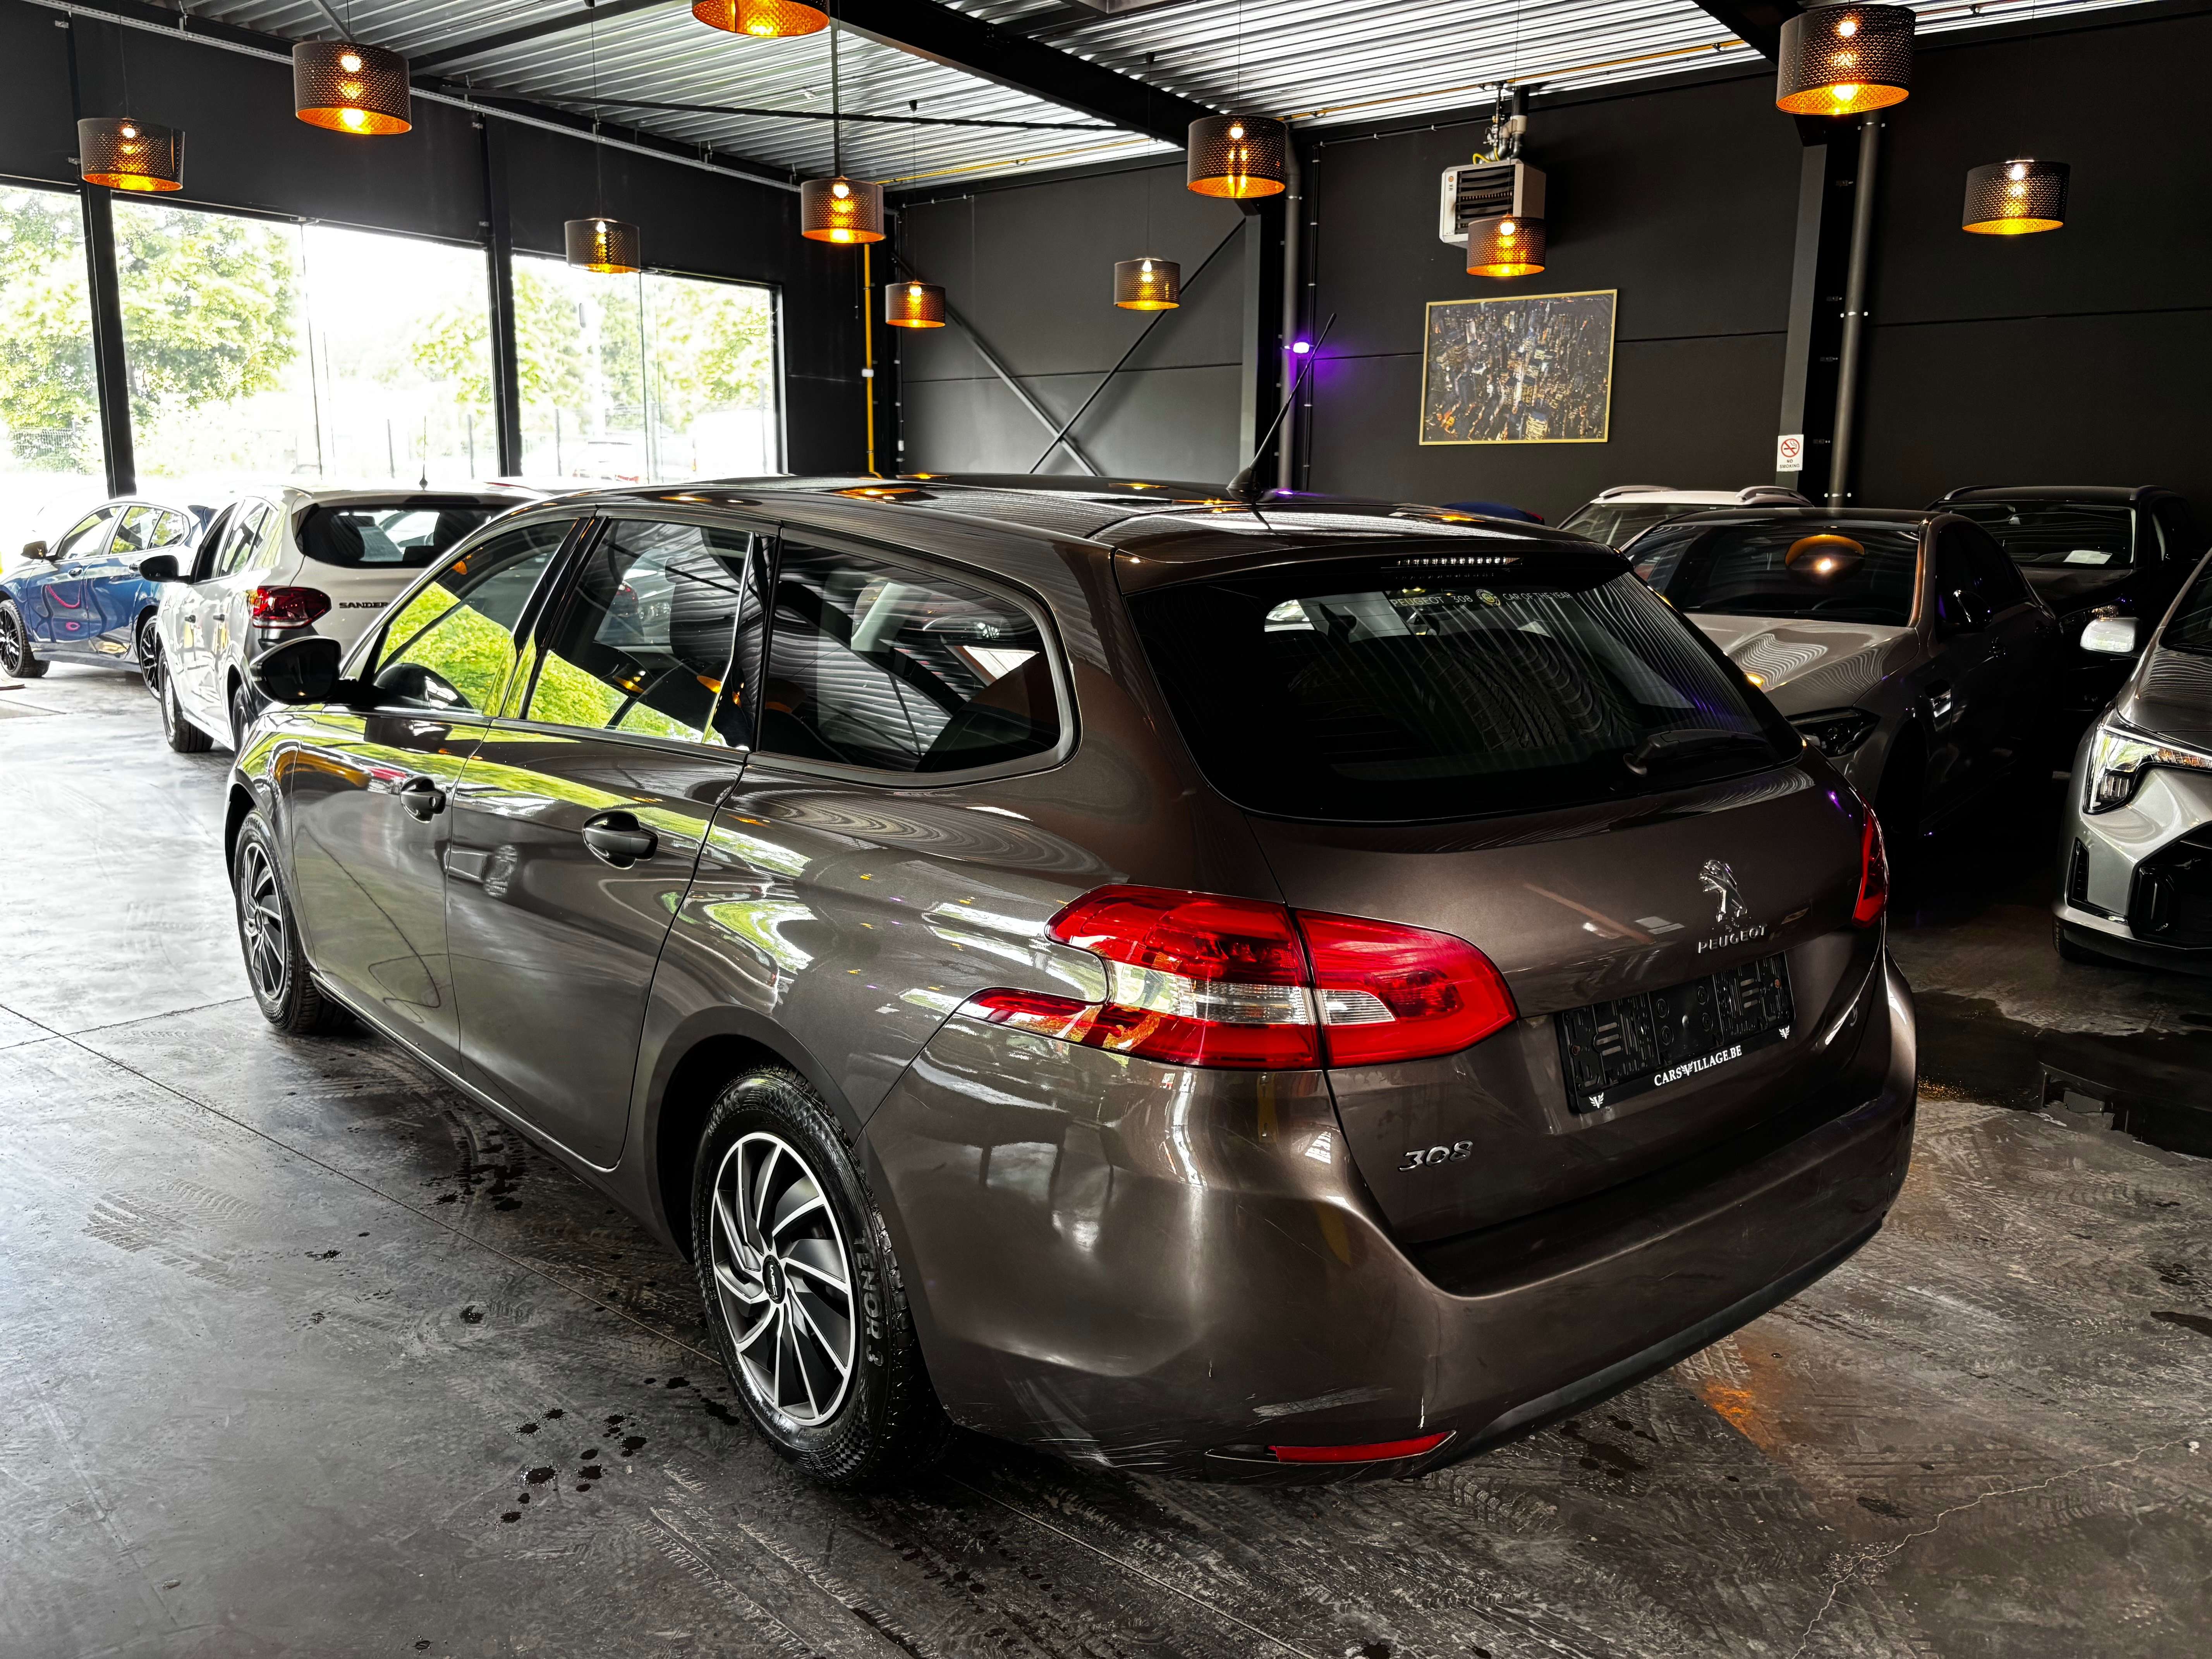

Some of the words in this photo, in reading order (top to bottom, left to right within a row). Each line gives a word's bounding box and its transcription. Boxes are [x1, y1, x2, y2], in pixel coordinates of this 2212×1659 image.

[1389, 597, 1444, 606] PEUGEOT
[1698, 923, 1768, 954] PEUGEOT
[1654, 1045, 1742, 1086] CARSVILLAGE.BE
[1398, 1140, 1473, 1171] 308
